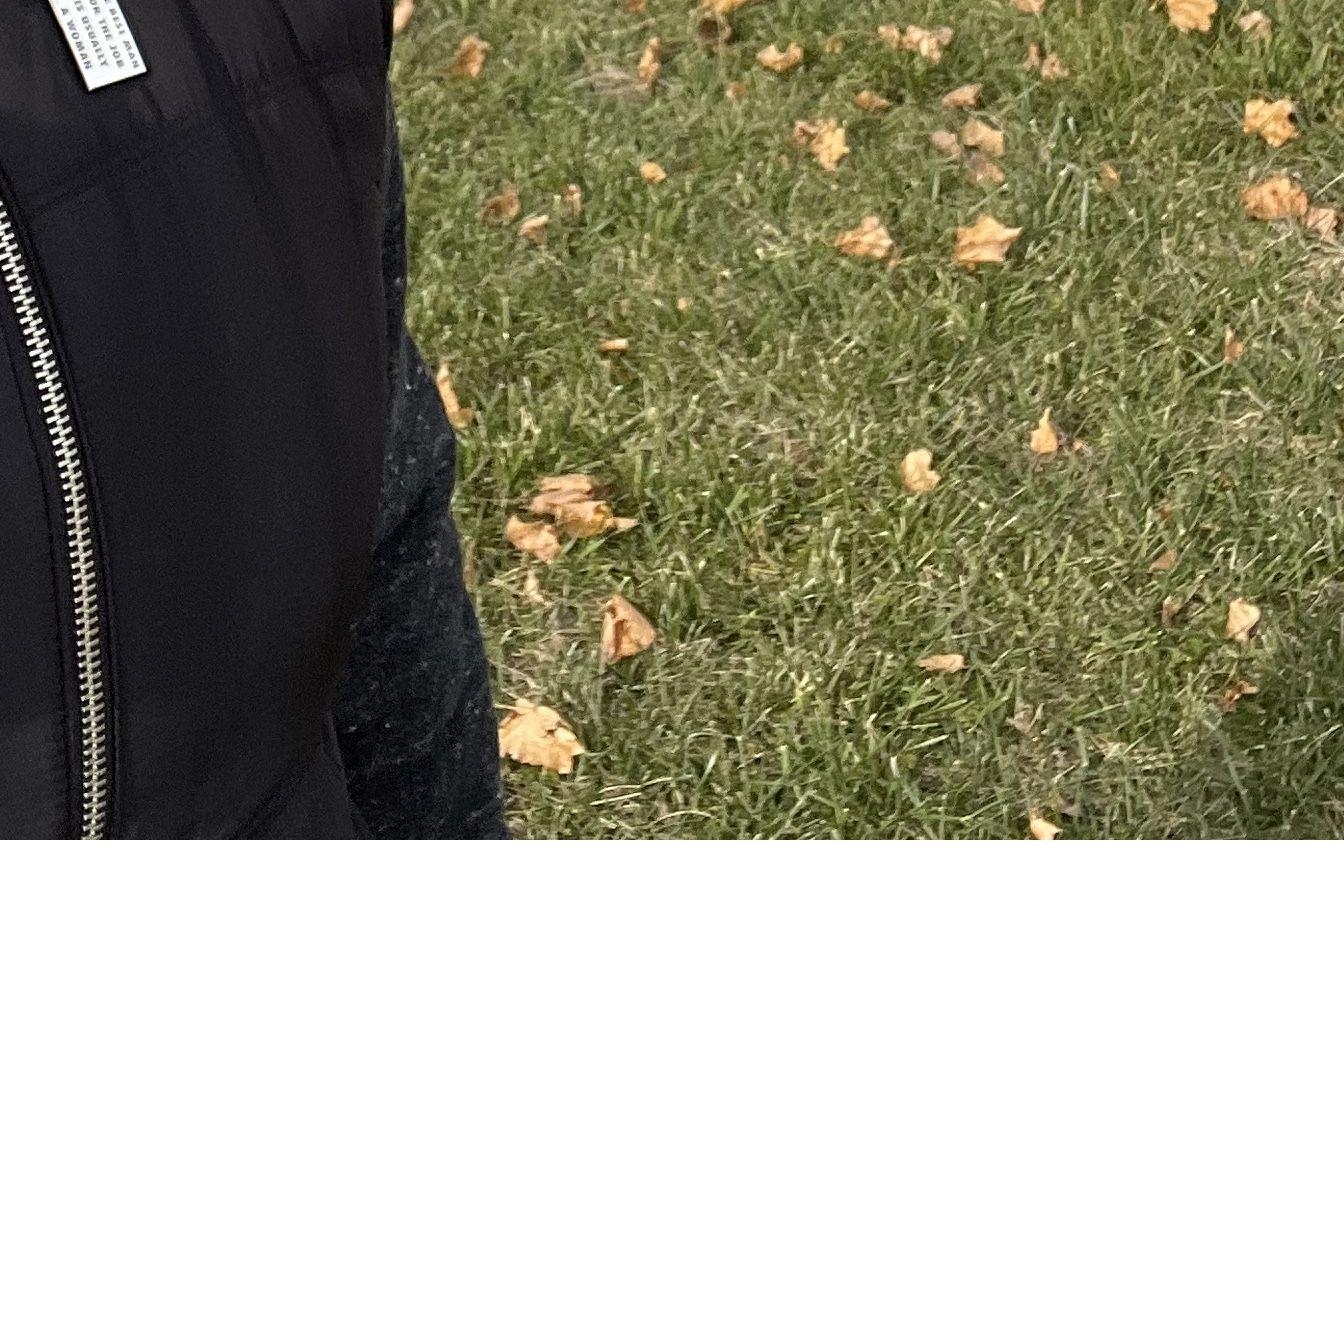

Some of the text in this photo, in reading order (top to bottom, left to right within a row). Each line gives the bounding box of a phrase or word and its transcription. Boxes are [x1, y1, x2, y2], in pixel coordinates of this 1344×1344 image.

[67, 20, 92, 70] WOMAN
[82, 16, 108, 67] USUALLY
[99, 19, 113, 41] THE
[110, 45, 124, 68] JOB
[124, 40, 140, 68] MAN
